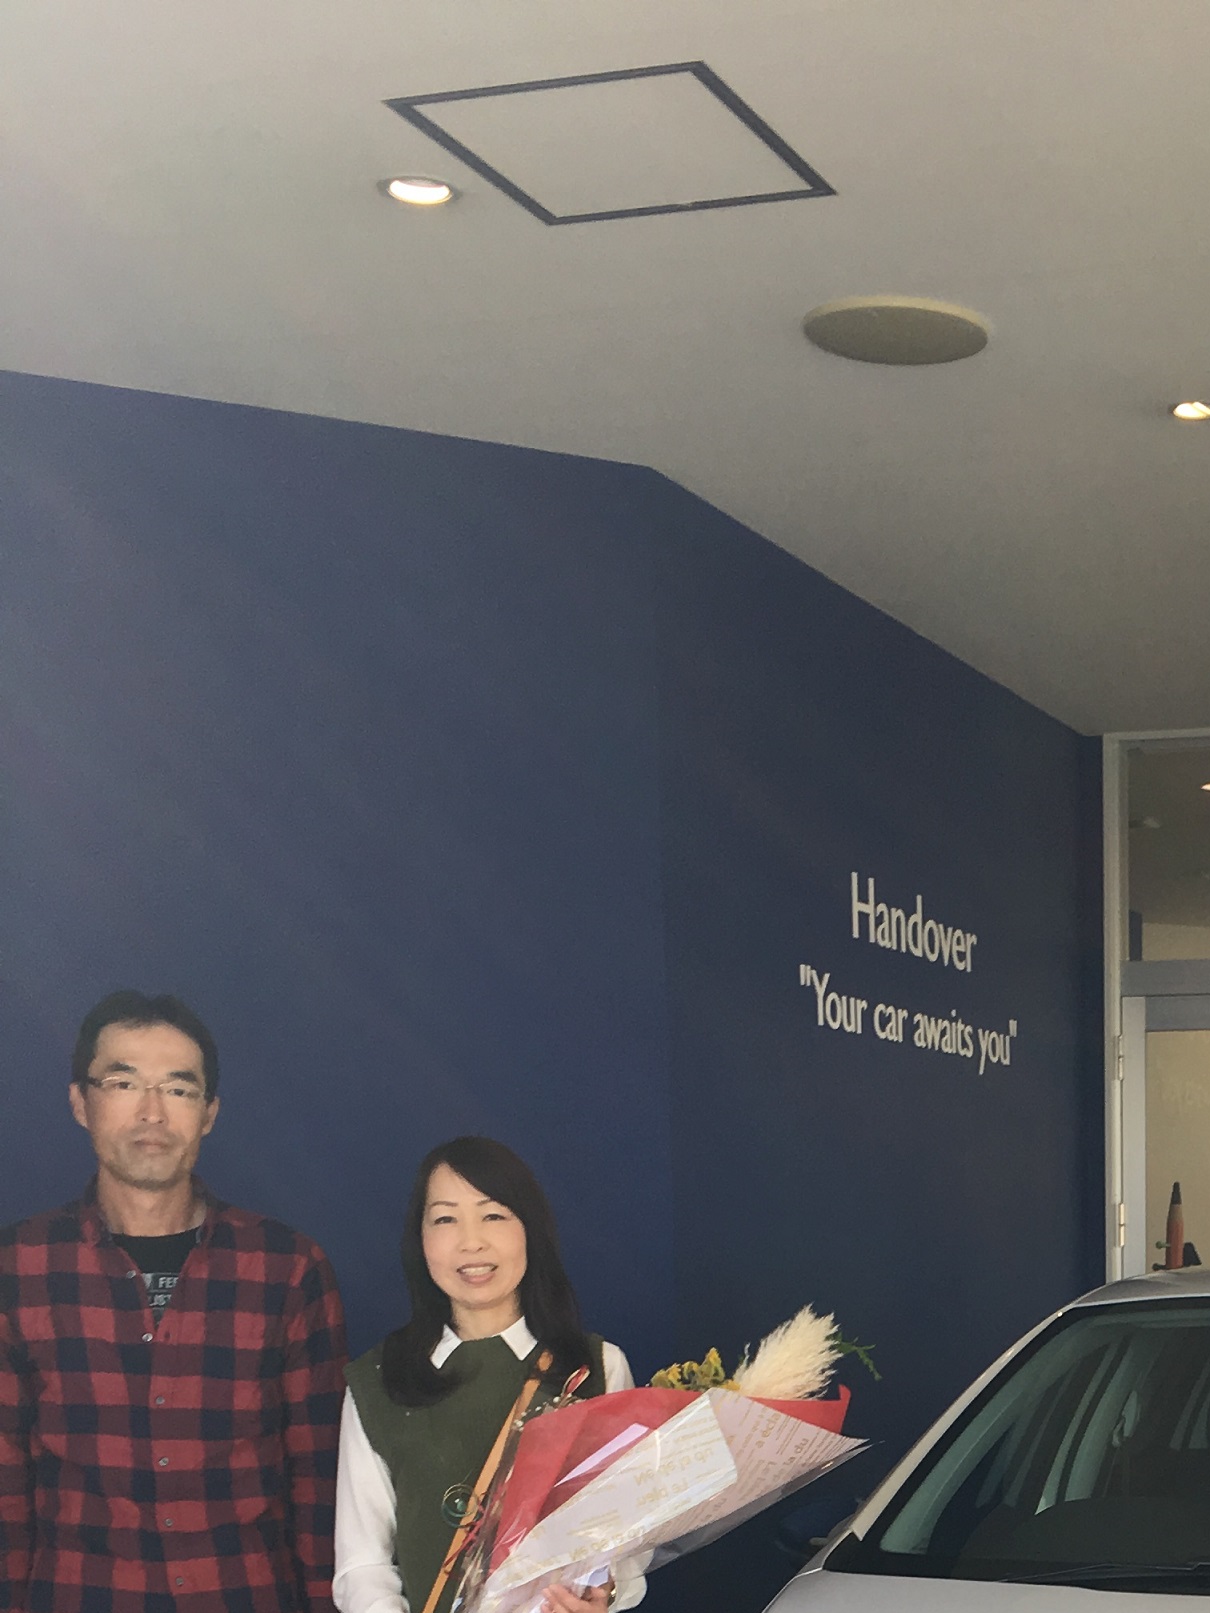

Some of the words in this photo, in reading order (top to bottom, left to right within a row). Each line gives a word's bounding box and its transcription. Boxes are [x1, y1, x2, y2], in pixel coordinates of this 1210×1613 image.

[851, 871, 977, 973] Handover
[800, 963, 868, 1034] "Your
[873, 1002, 909, 1043] car
[913, 1009, 974, 1058] awaits
[977, 1019, 1018, 1075] you"
